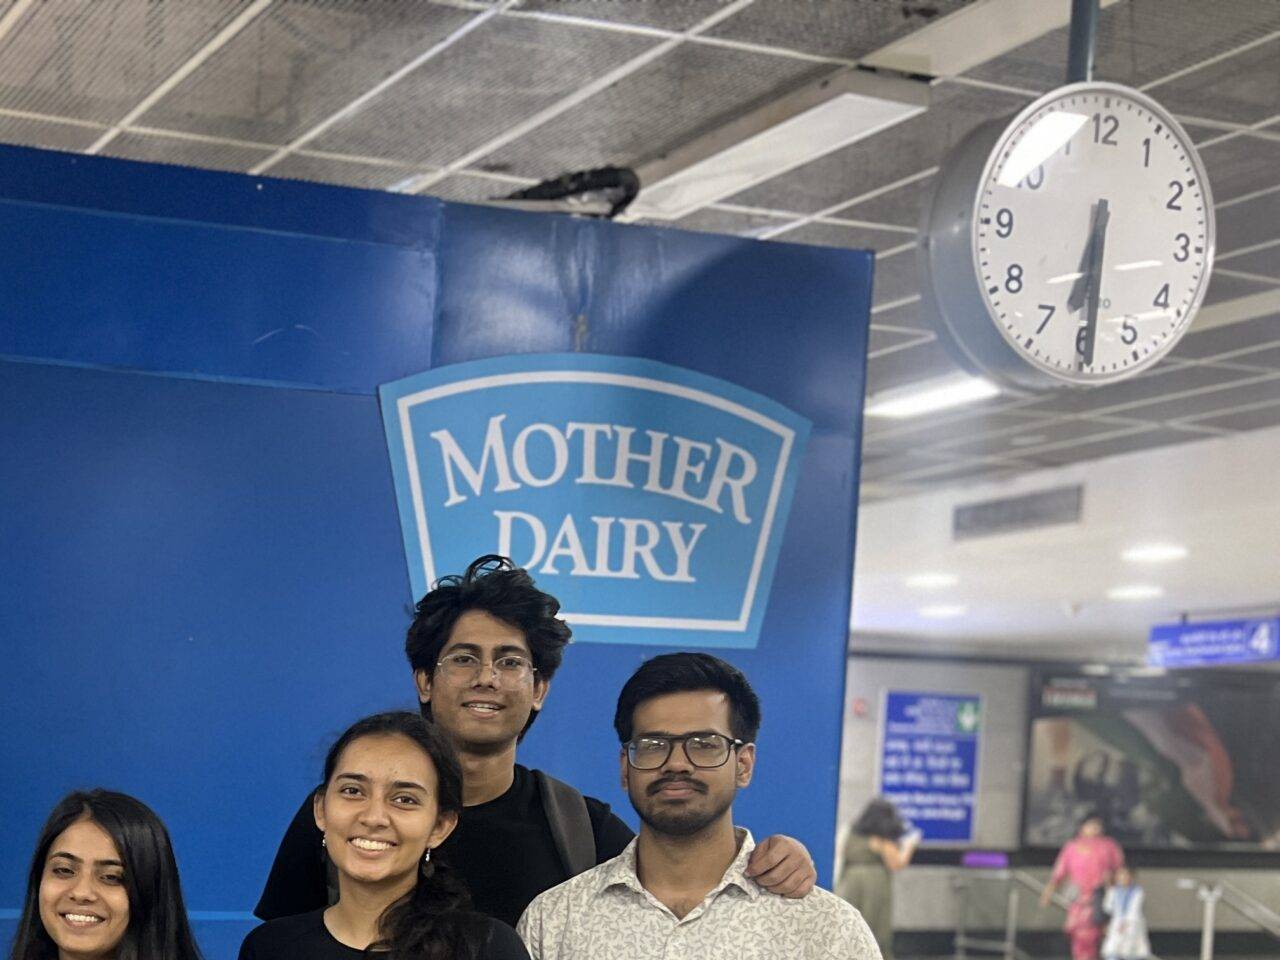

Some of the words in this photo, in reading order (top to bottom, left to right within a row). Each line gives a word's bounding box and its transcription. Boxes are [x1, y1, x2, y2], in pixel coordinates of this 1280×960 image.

[1092, 113, 1119, 145] 12
[1143, 138, 1152, 168] 1
[1166, 181, 1184, 211] 2
[995, 208, 1013, 238] 9
[1173, 233, 1190, 262] 3
[1005, 264, 1023, 294] 8
[1153, 283, 1170, 310] 4
[1037, 304, 1056, 334] 7
[1121, 314, 1138, 345] 5
[430, 413, 758, 524] MOTHER
[493, 510, 707, 583] DAIRY
